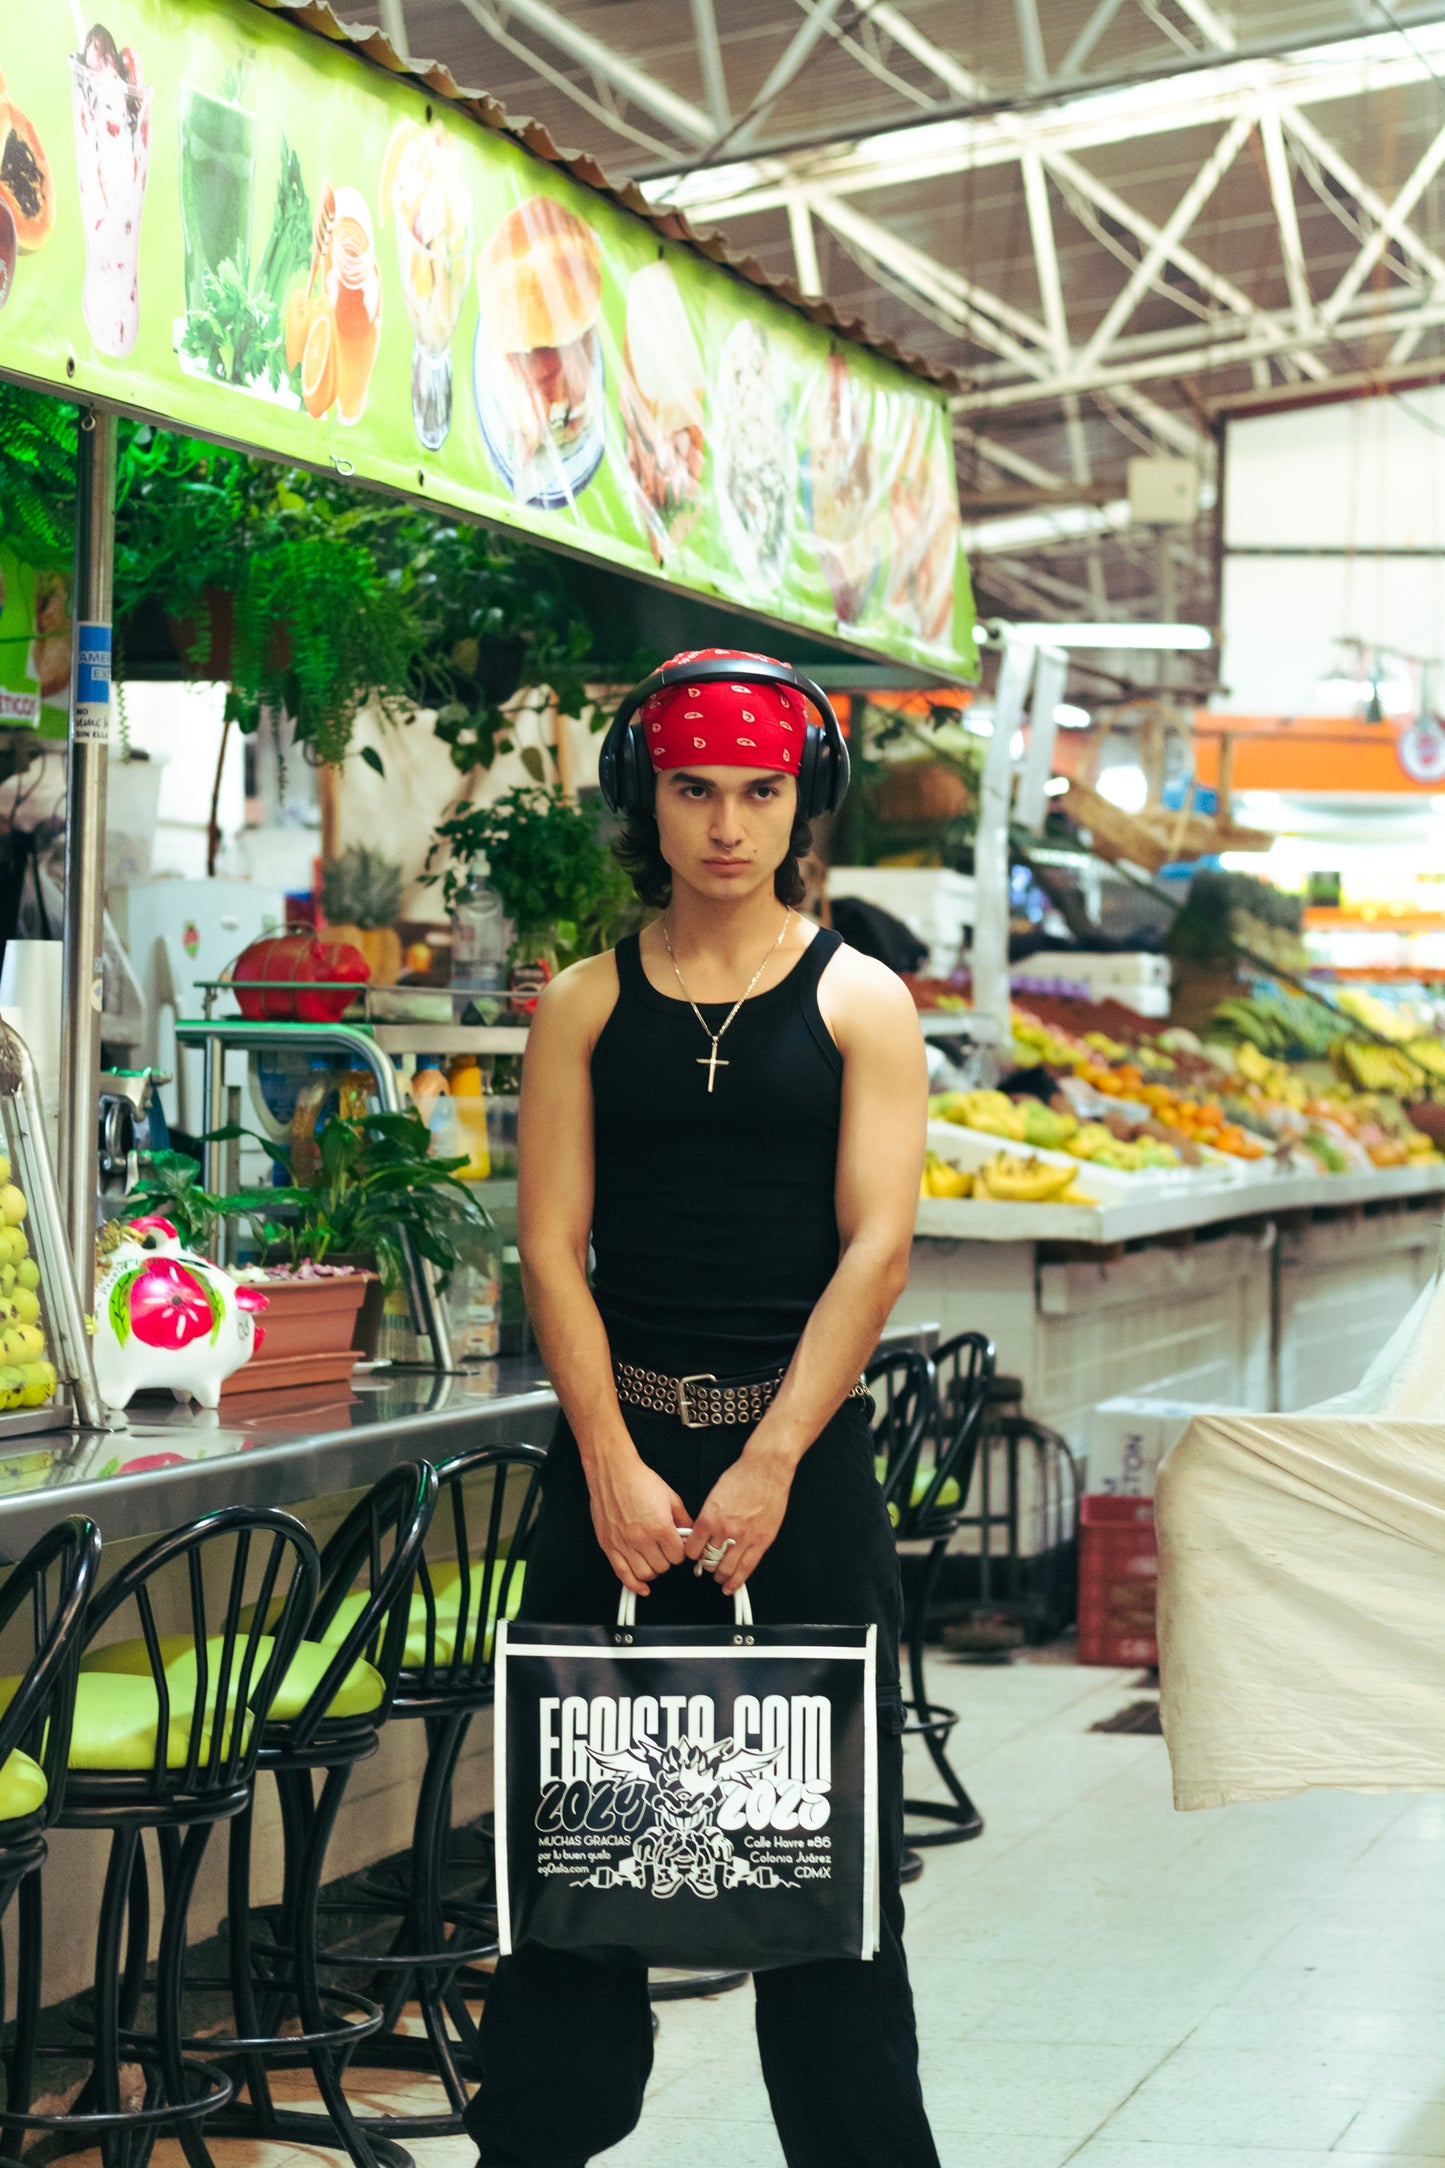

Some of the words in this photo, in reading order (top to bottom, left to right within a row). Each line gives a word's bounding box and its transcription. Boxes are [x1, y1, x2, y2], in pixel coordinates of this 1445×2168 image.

[534, 1780, 650, 1832] 2024
[717, 1778, 832, 1831] 2025
[538, 1835, 582, 1846] MUCHAS
[583, 1835, 631, 1846] GRACIAS
[744, 1835, 772, 1848] Calle
[773, 1835, 805, 1848] Havre
[806, 1836, 832, 1848] #86
[538, 1852, 552, 1863] por
[553, 1848, 562, 1860] tu
[562, 1848, 587, 1860] buen
[587, 1848, 612, 1863] gusto
[750, 1851, 793, 1863] Colonia
[795, 1851, 832, 1864] Juárez
[793, 1866, 832, 1879] CDMX
